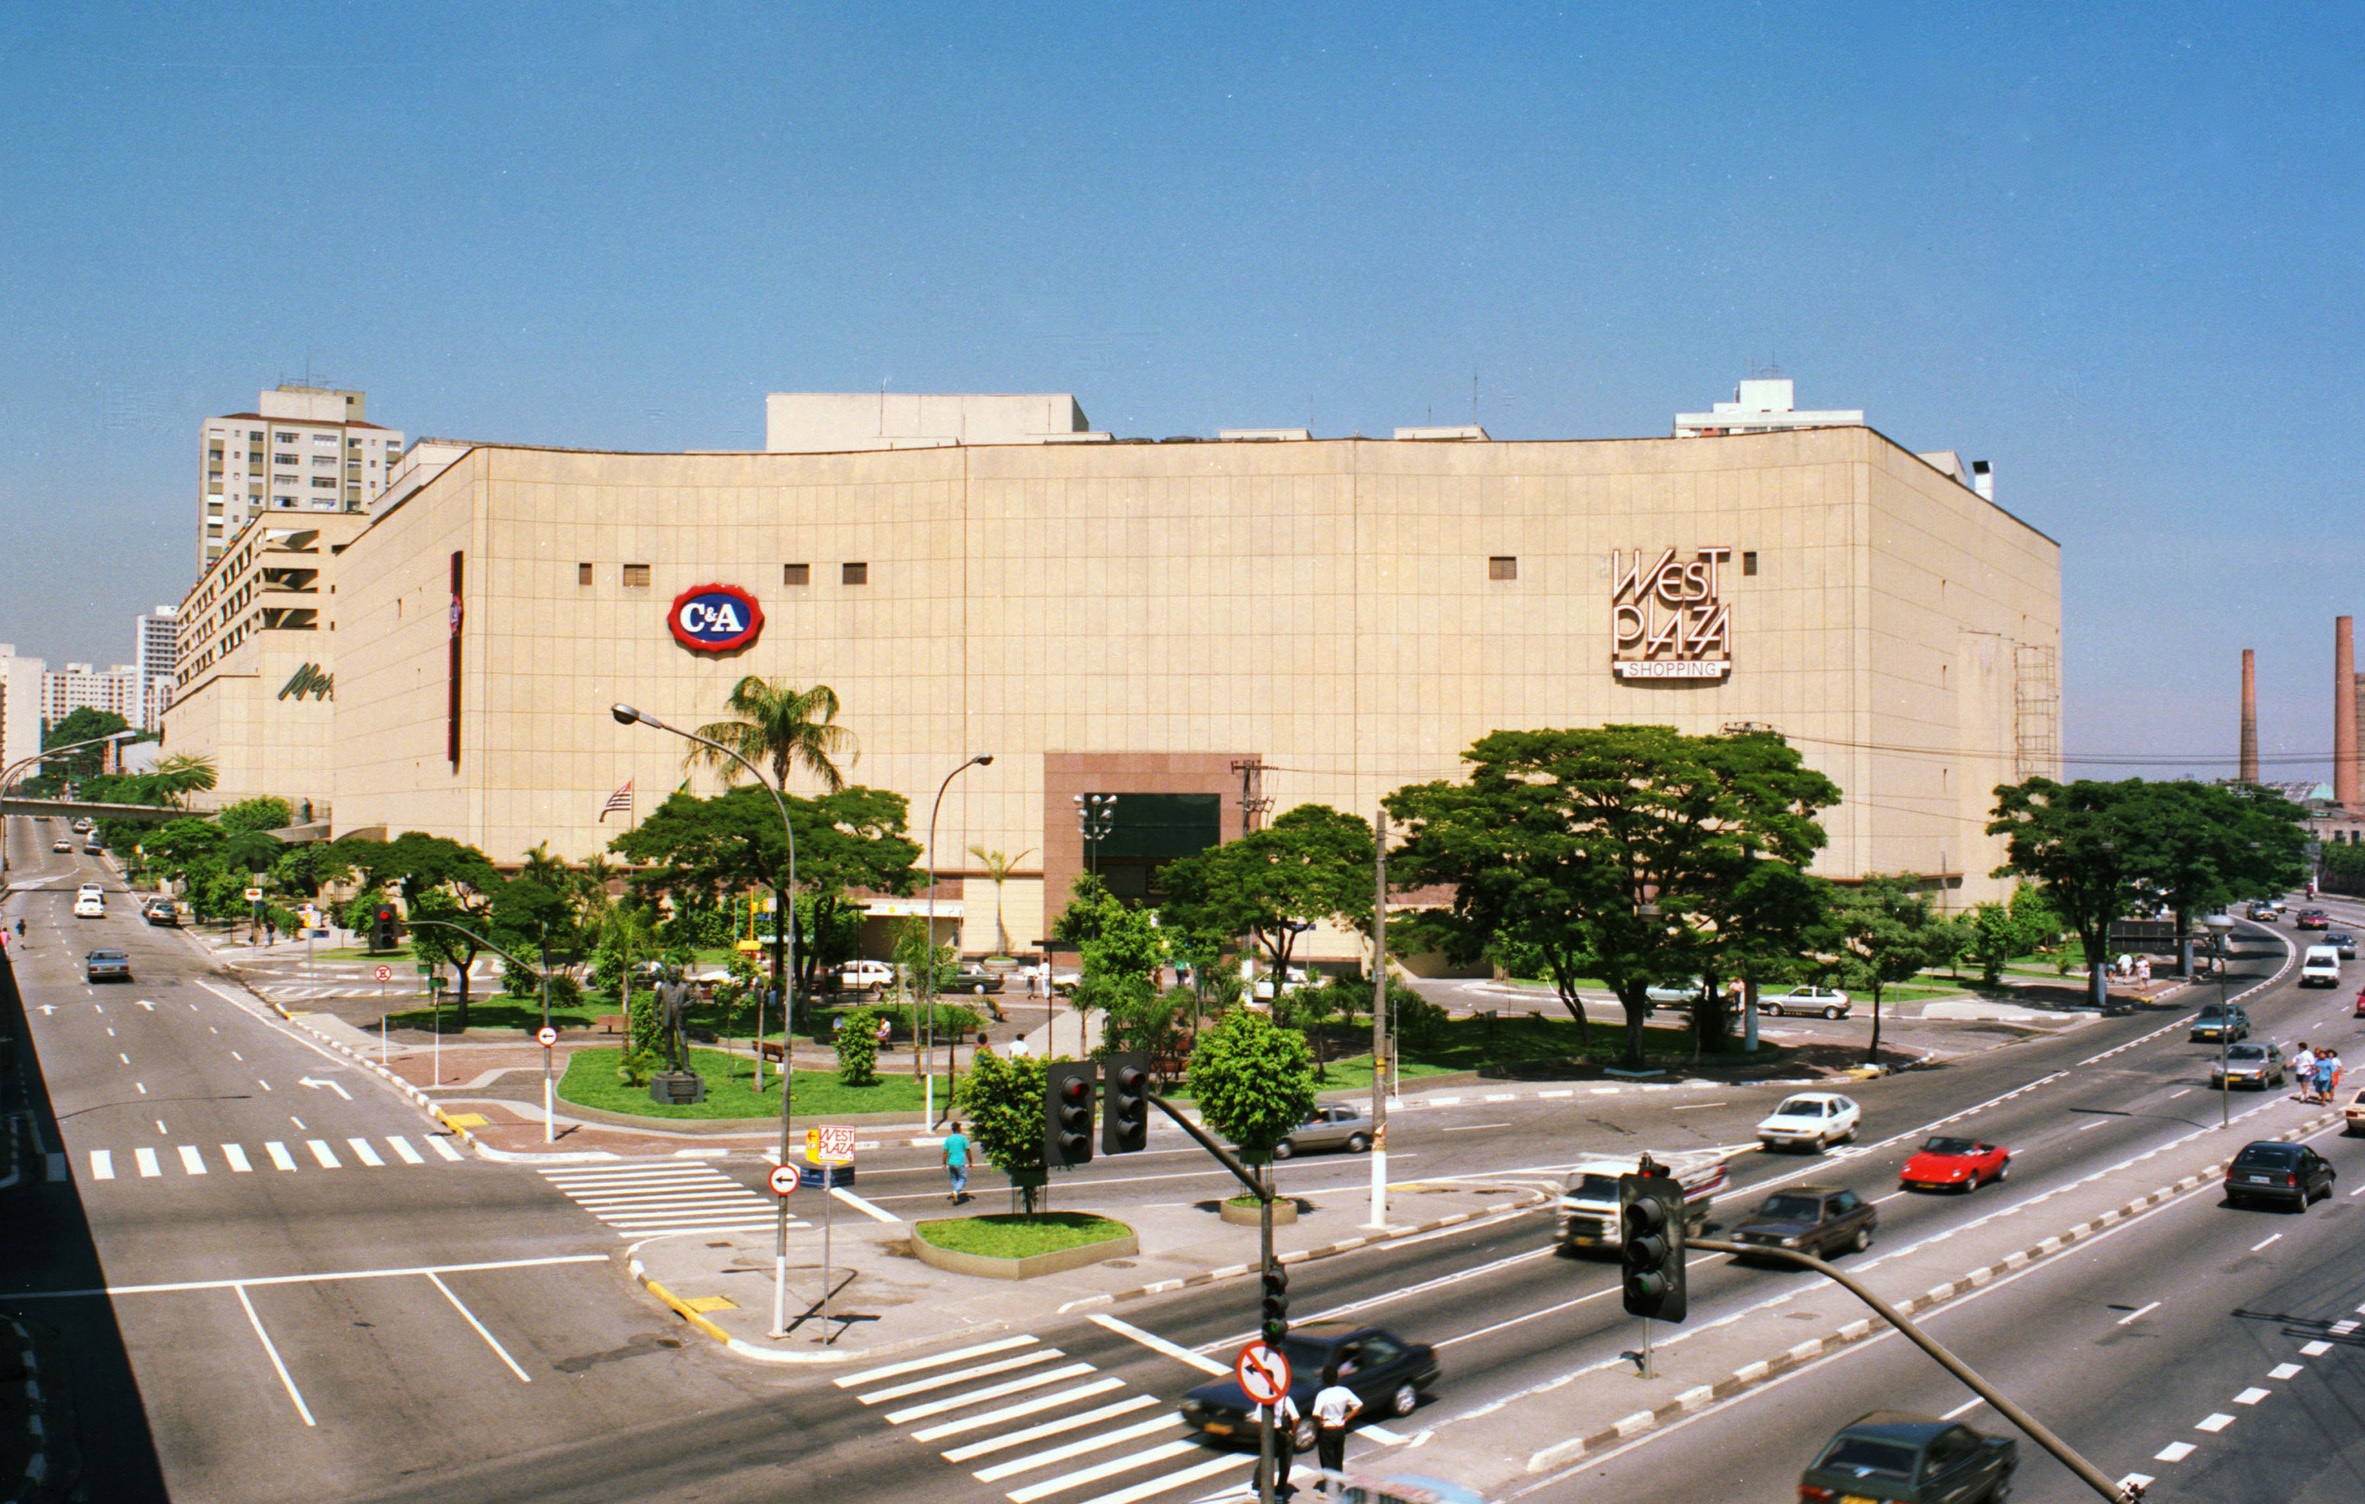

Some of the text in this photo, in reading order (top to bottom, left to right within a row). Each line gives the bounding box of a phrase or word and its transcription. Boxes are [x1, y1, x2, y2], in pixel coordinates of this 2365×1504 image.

[679, 602, 744, 633] C&A
[1612, 593, 1731, 655] PLAZA
[1628, 662, 1717, 677] SHOPPING
[818, 1128, 854, 1142] WEST
[818, 1140, 854, 1154] PLAZA
